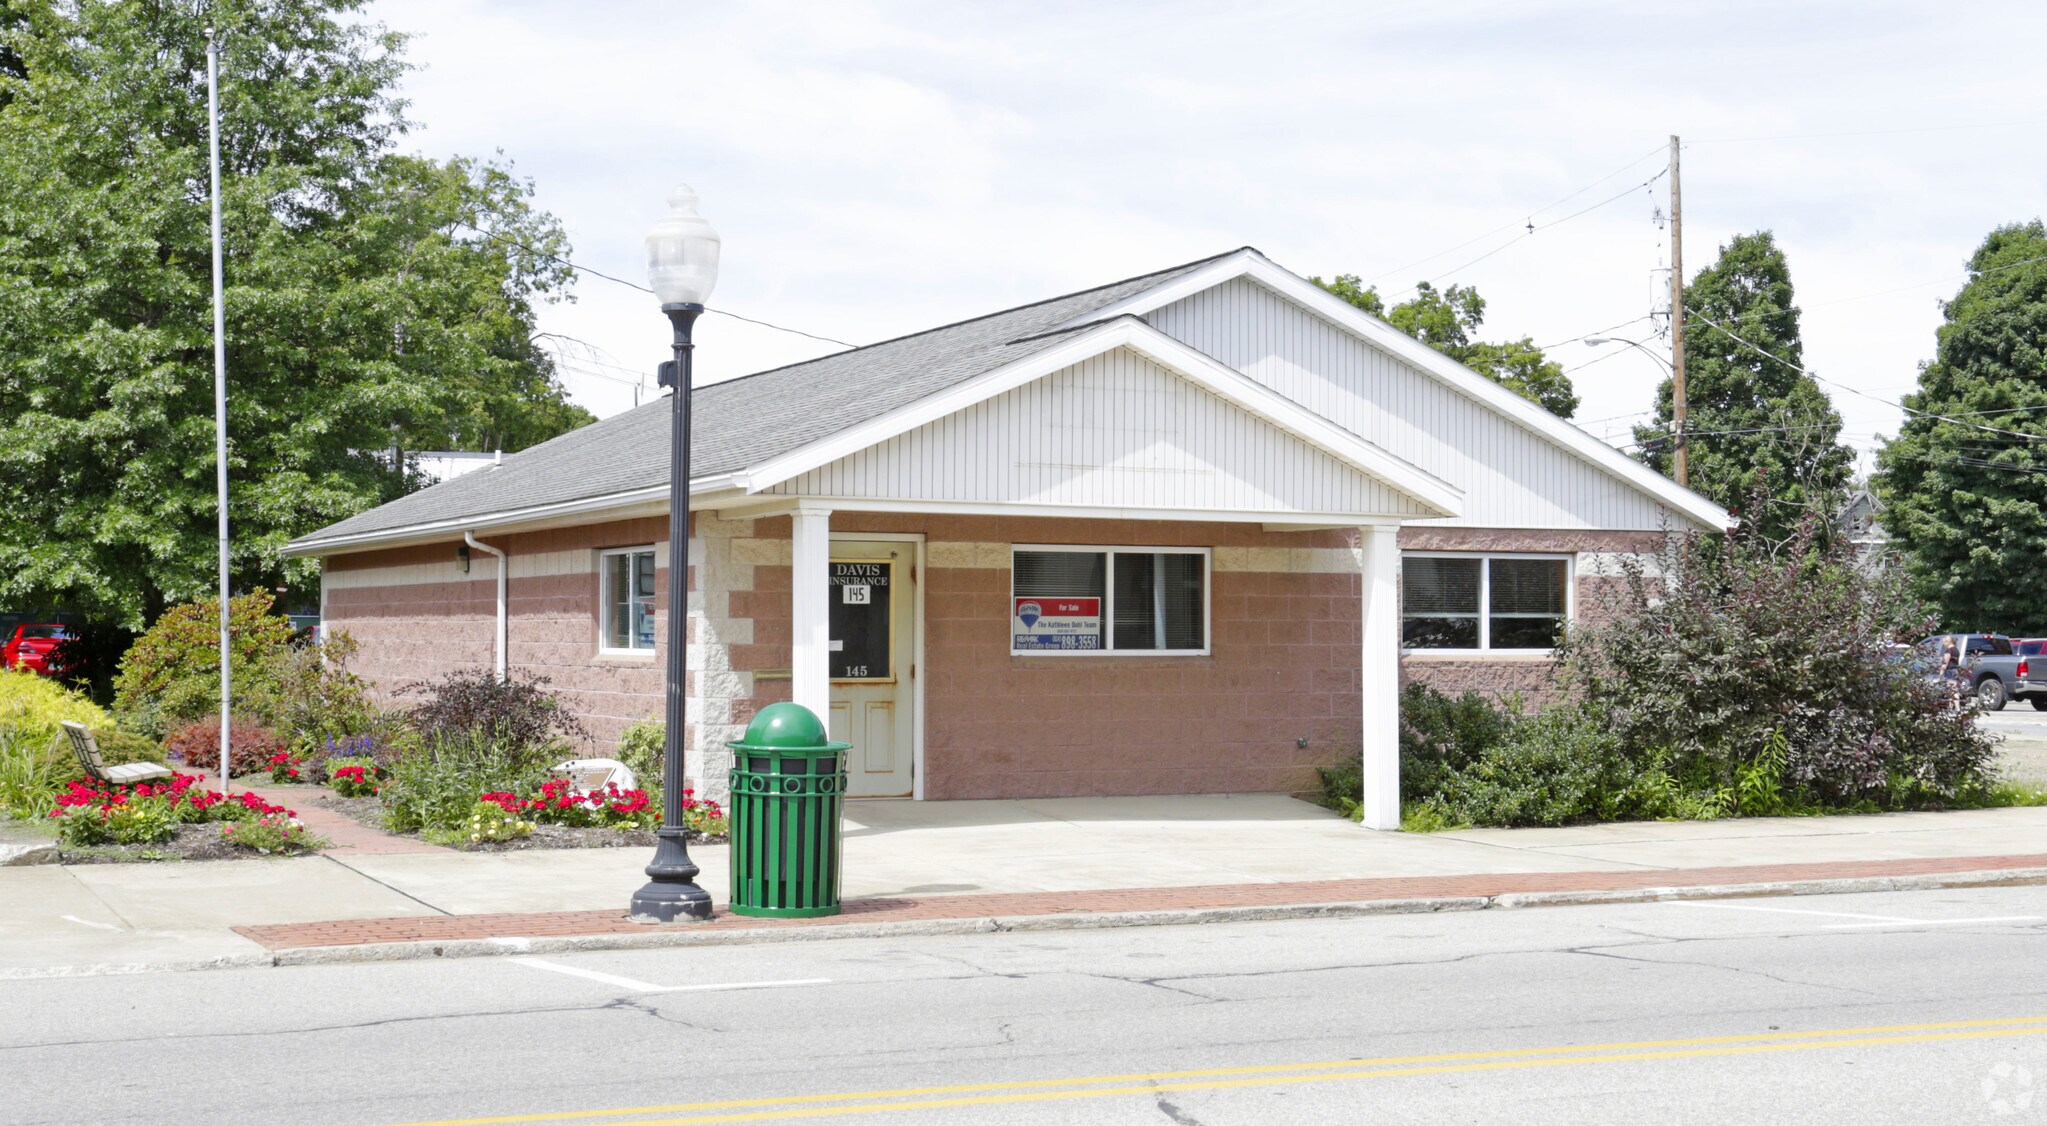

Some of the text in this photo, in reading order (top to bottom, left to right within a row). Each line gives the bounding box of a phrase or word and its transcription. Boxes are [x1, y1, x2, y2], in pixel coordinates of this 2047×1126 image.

[837, 564, 880, 576] DAVIS
[829, 577, 888, 586] INSURANCE
[849, 587, 865, 601] 145
[845, 666, 868, 677] 145
